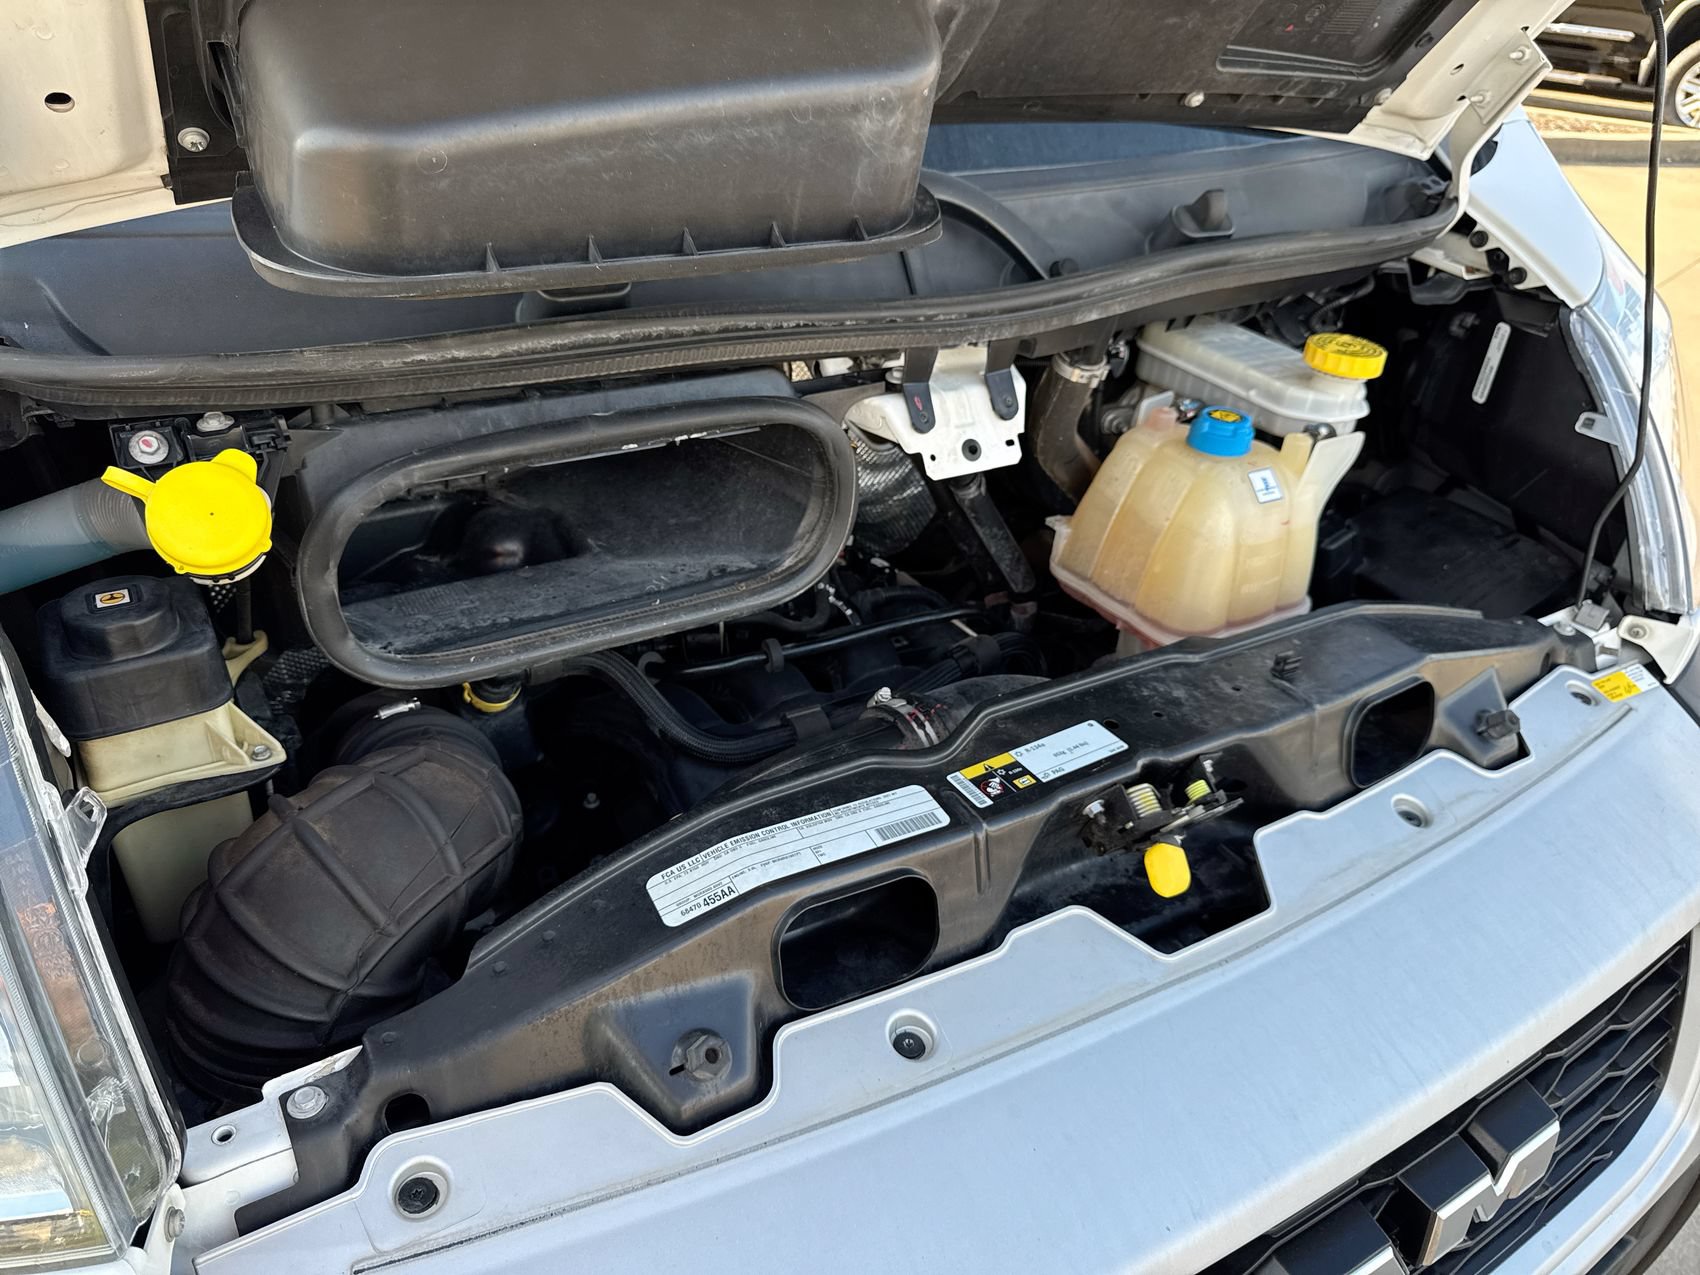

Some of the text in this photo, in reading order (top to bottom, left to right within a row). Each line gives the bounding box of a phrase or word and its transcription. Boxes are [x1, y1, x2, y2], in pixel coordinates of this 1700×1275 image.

[703, 843, 729, 859] VEHICLE
[729, 832, 760, 847] EMISSION
[761, 822, 789, 836] CONTROL
[790, 811, 832, 828] INFORMATION
[661, 870, 675, 880] FCA
[676, 863, 687, 872] US
[687, 857, 701, 867] LLC
[680, 903, 702, 917] 68470
[702, 885, 736, 907] 455AA
